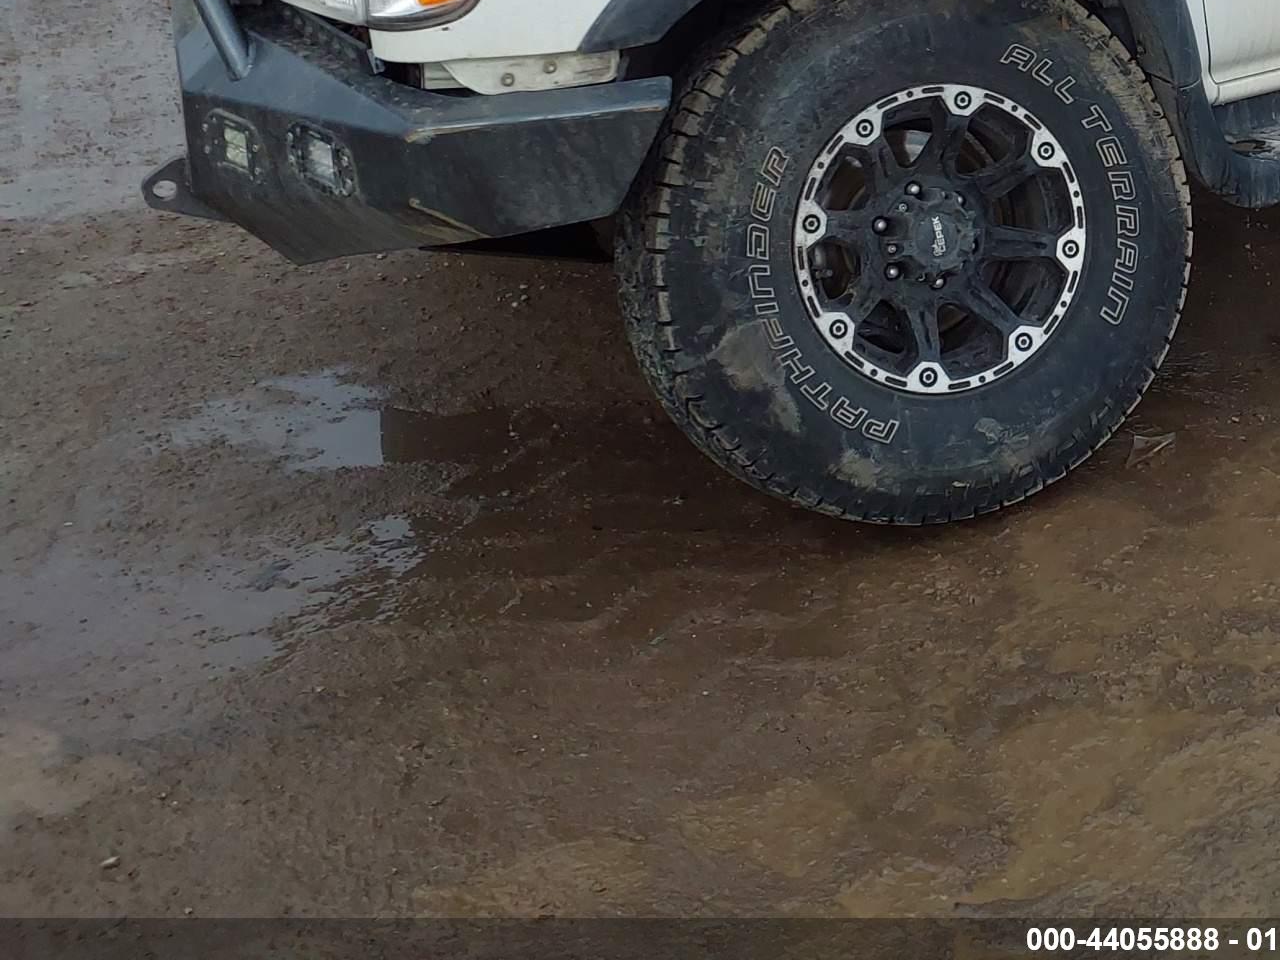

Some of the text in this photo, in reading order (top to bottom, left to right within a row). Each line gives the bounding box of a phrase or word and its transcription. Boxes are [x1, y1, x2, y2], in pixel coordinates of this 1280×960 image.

[746, 146, 899, 444] PATHFINDER
[931, 216, 947, 252] CEPEK
[1000, 43, 1140, 326] ALL TERRAIN
